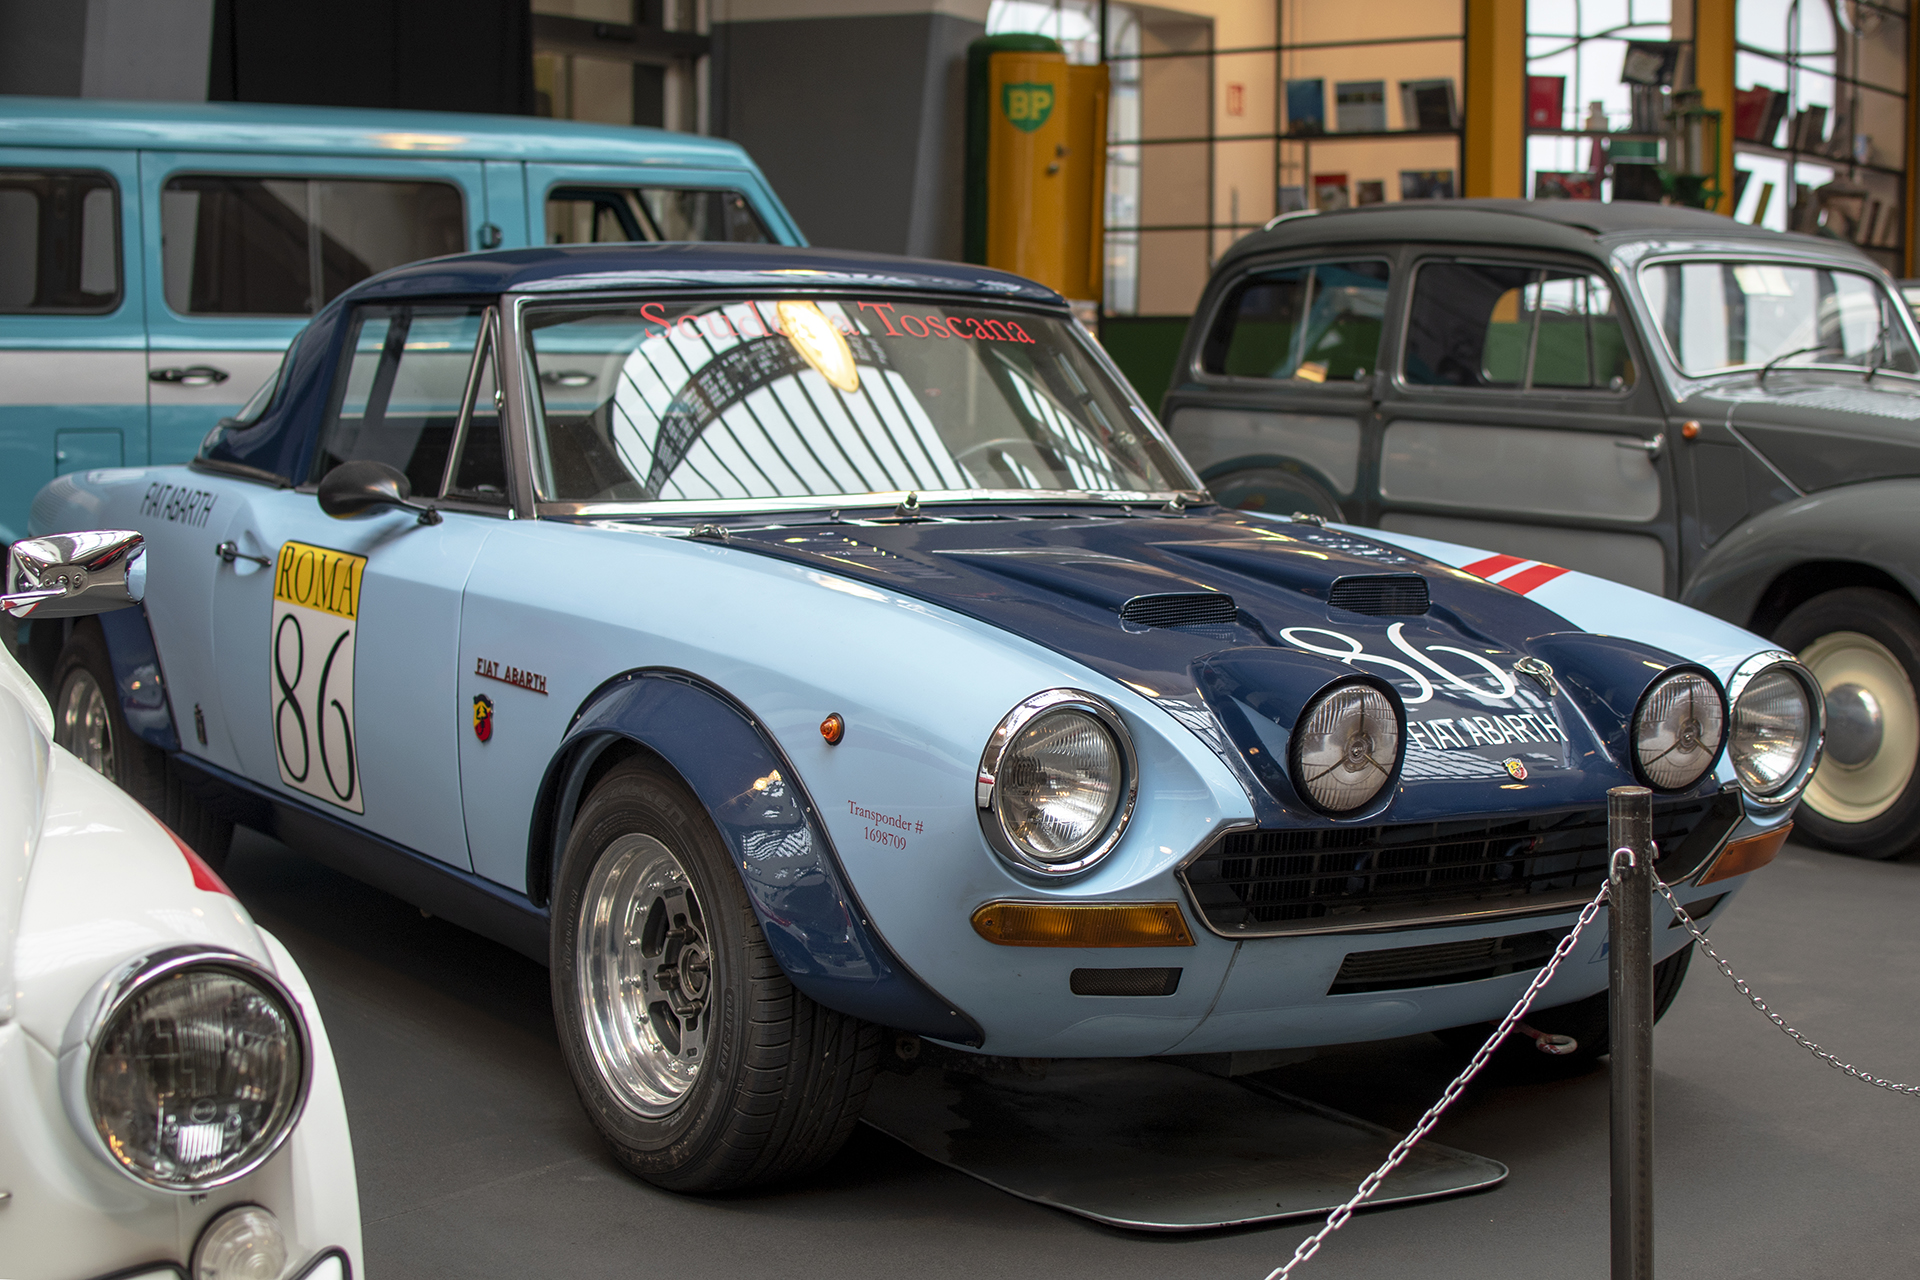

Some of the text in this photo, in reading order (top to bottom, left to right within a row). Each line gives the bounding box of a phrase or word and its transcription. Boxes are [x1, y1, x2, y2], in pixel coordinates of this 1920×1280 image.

[1008, 88, 1052, 120] BP
[639, 301, 1036, 345] Scudea Toscana
[276, 545, 355, 618] ROMA
[476, 657, 547, 693] FIAT ABARTH
[1279, 621, 1516, 704] 86
[274, 612, 355, 802] 86
[1406, 713, 1569, 751] FIAT ABARTH
[847, 799, 924, 835] Transponder #
[864, 826, 907, 851] 1698709
[719, 994, 734, 1073] OUTSIDE
